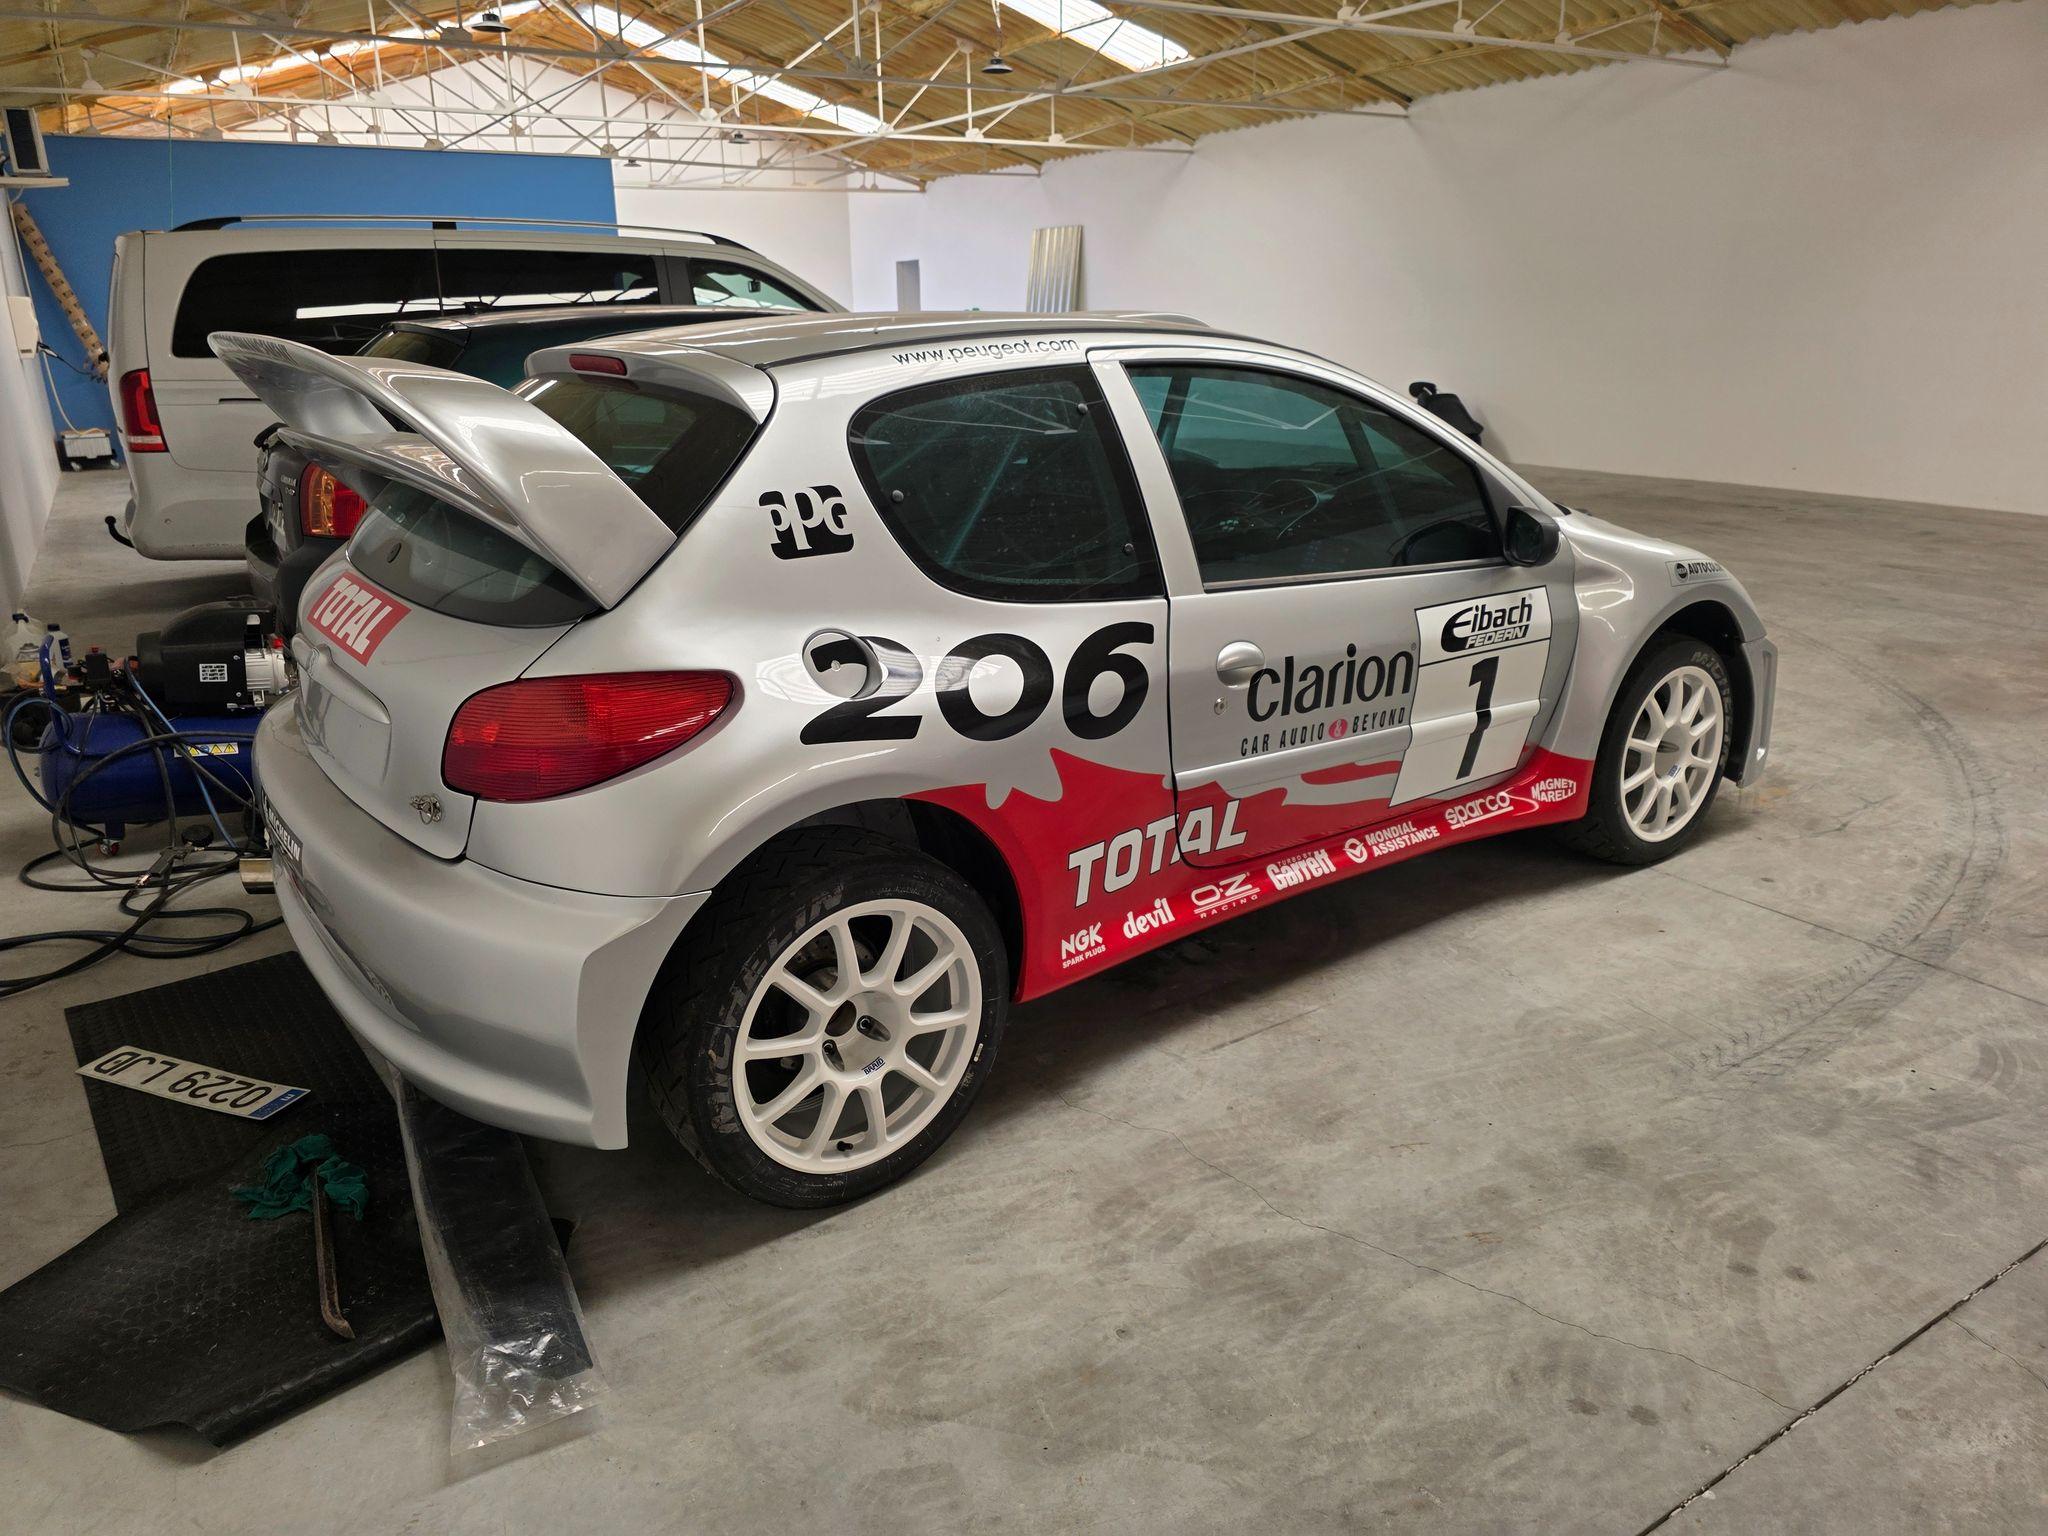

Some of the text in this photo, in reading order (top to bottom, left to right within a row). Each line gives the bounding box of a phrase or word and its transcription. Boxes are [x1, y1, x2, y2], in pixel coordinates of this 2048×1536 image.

[892, 338, 1080, 364] www.peugeot.com
[313, 577, 394, 655] TOTAL
[1441, 597, 1533, 653] Eibach
[1464, 624, 1526, 649] FEDERN
[800, 621, 1155, 746] 206
[1247, 642, 1416, 722] clarion
[1241, 733, 1270, 757] CAR
[1280, 723, 1325, 748] AUDIO
[1352, 707, 1406, 733] BEYOND
[1455, 656, 1499, 780] 1
[1445, 791, 1511, 828] sparco
[1068, 798, 1249, 909] TOTAL
[1365, 821, 1418, 847] MONDIAL
[1372, 825, 1440, 858] ASSISTANCE
[1266, 848, 1336, 891] Garrett
[1123, 897, 1176, 939] devil
[1200, 894, 1259, 919] RACING
[1061, 921, 1104, 960] NGK
[1062, 945, 1106, 969] SPARK PLUGS
[862, 1056, 886, 1077] BRAID
[168, 1070, 273, 1109] 0229
